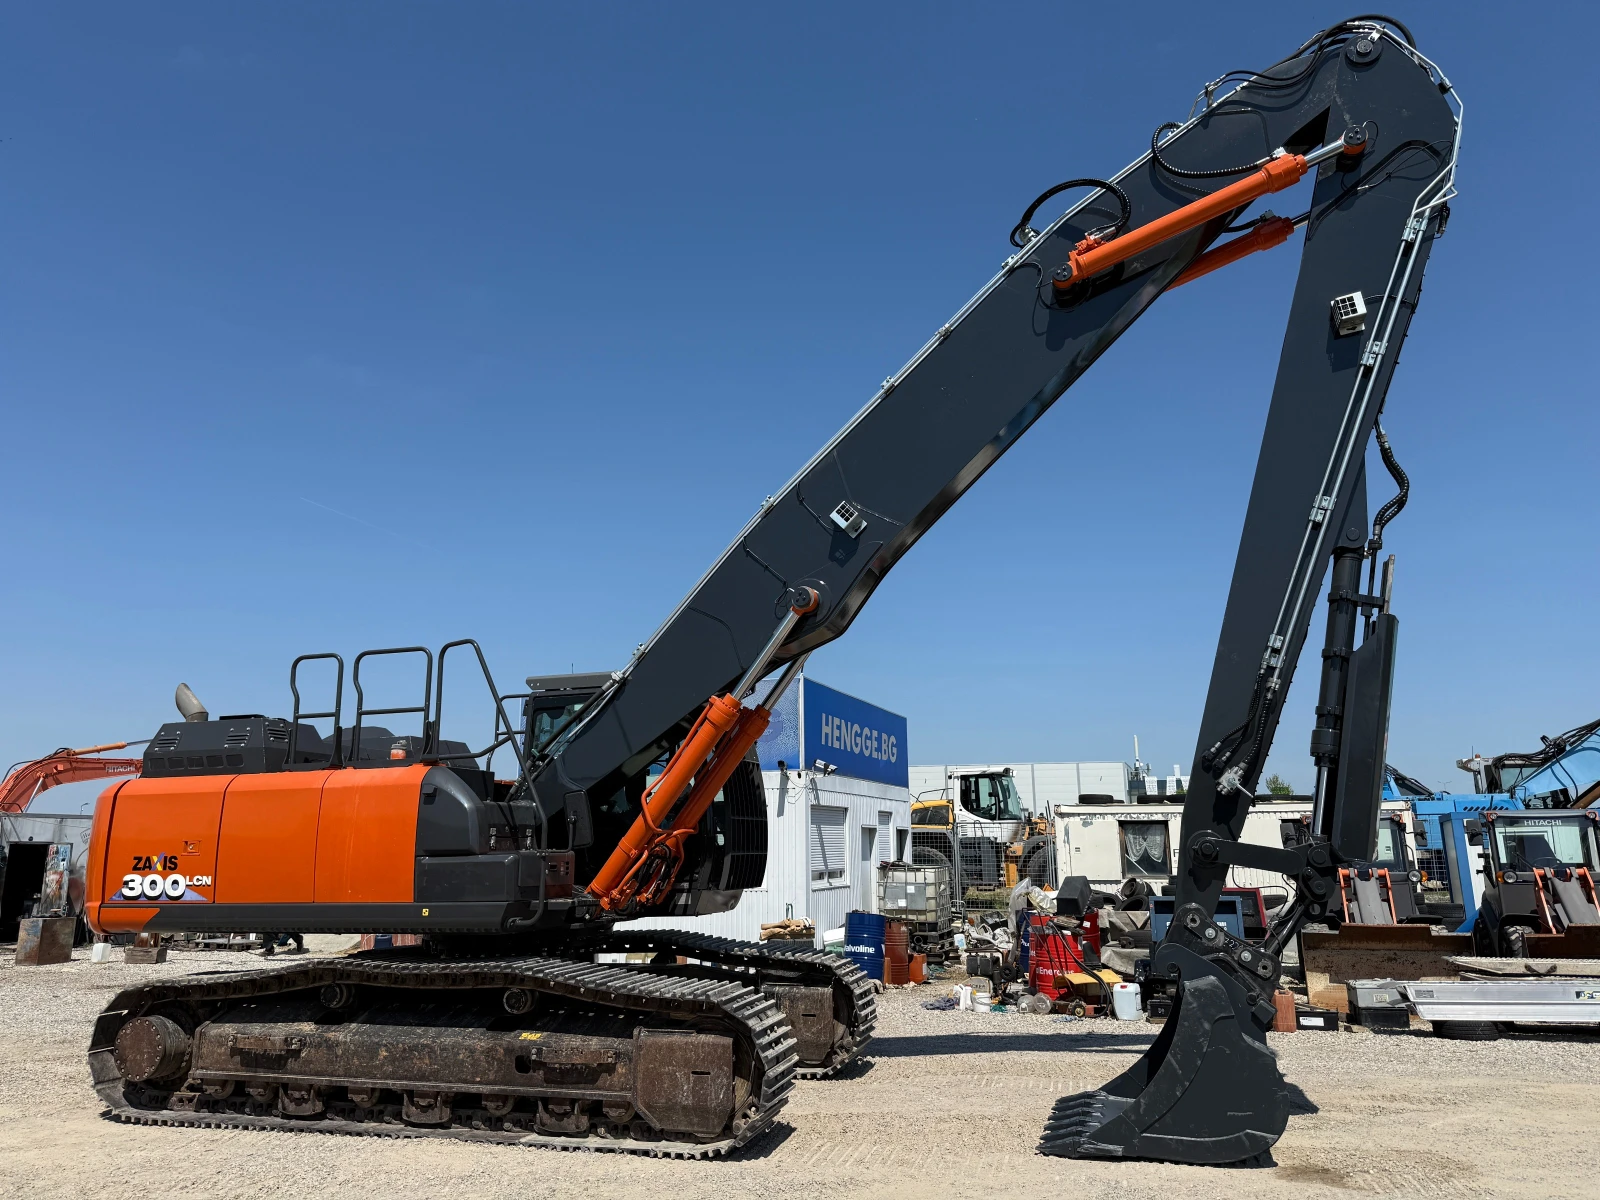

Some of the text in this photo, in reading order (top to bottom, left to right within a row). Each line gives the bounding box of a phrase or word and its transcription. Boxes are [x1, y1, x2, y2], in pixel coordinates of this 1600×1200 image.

[821, 713, 897, 763] HENGGE.BG
[106, 765, 135, 773] HITACHI
[132, 852, 178, 871] ZAXIS
